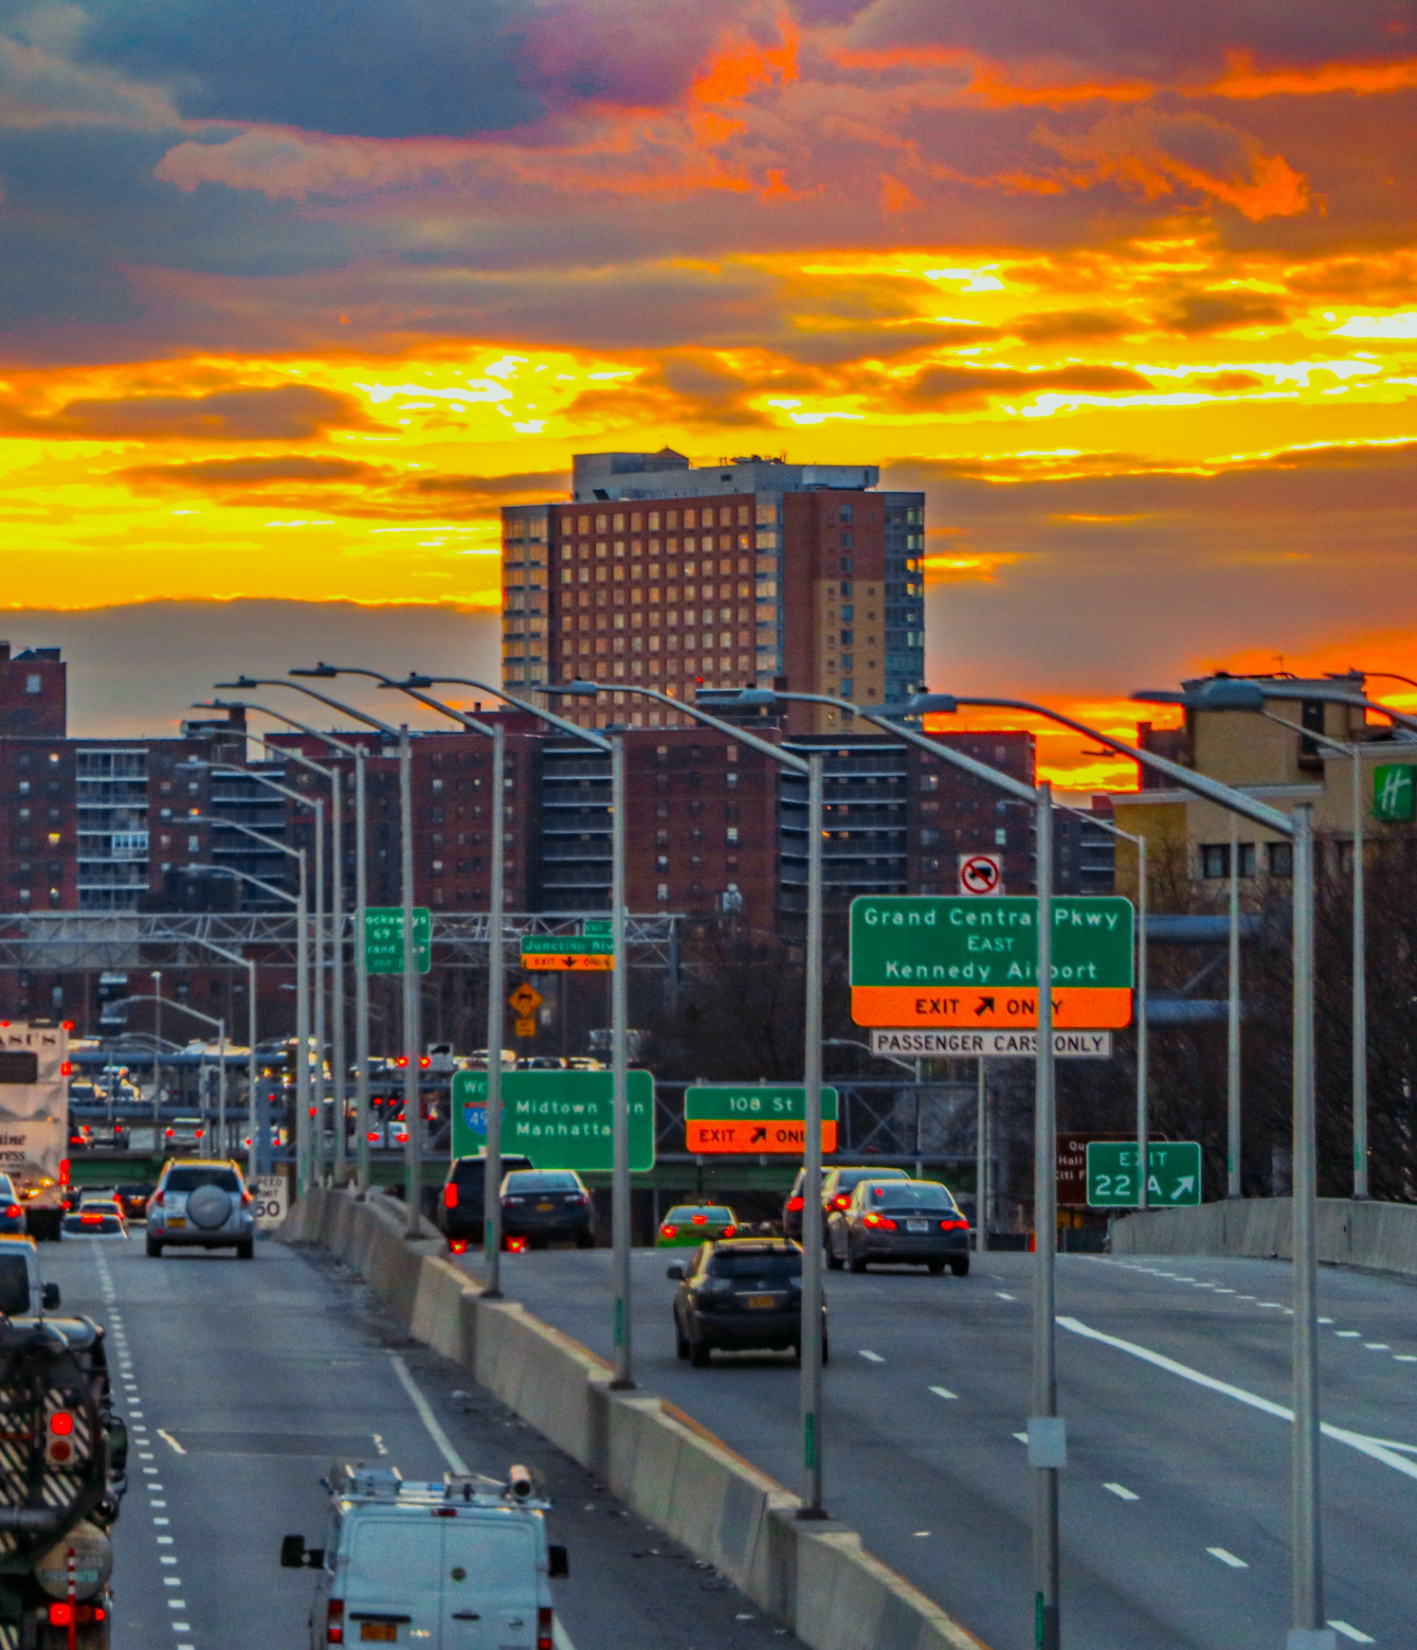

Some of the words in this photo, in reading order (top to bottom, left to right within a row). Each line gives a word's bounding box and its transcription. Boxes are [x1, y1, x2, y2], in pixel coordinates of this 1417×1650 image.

[864, 908, 936, 926] Grand
[948, 908, 1032, 926] Centra
[1054, 908, 1118, 931] Pkwy
[373, 928, 390, 939] 69
[367, 944, 396, 955] rand
[525, 940, 586, 952] Junction
[592, 940, 614, 952] Blv
[967, 936, 1015, 952] EAST
[535, 957, 555, 966] EXIT
[885, 960, 991, 983] Kennedy
[915, 998, 960, 1015] EXIT
[1006, 999, 1063, 1015] ONY
[878, 1033, 983, 1051] PASSENGER
[1054, 1035, 1103, 1051] ONLY
[516, 1100, 598, 1115] Midtown
[729, 1096, 761, 1112] 108
[772, 1096, 793, 1112] St
[516, 1122, 612, 1137] Manhatta
[699, 1128, 735, 1143] EXIT
[256, 1200, 280, 1218] 50
